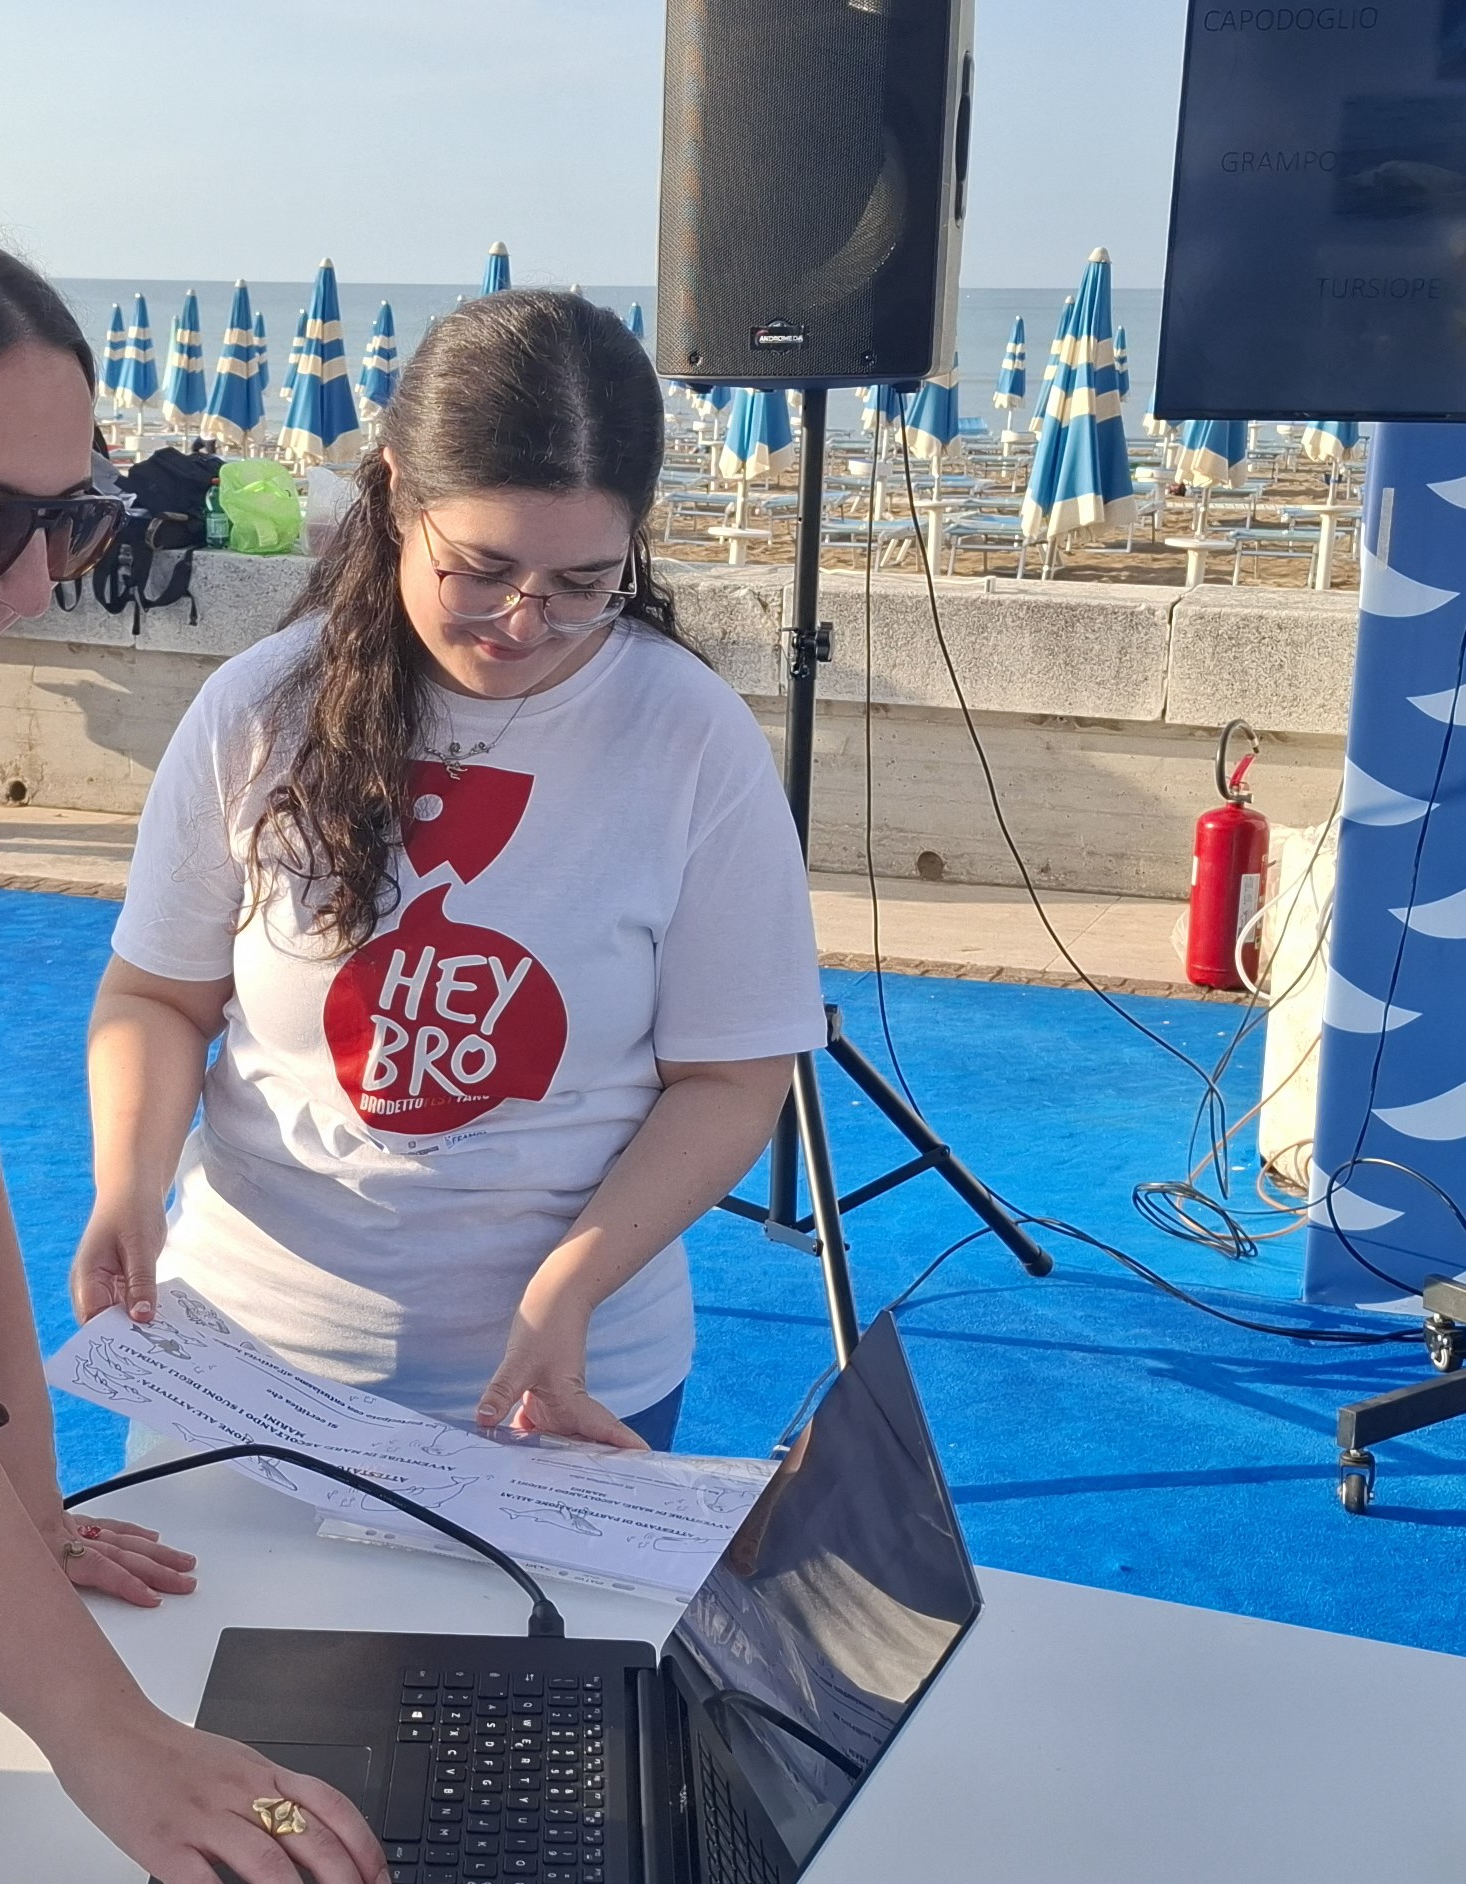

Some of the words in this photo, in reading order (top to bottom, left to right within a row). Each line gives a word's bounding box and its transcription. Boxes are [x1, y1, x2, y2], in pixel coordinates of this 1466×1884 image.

[1203, 6, 1379, 33] CAPODOGLIO
[1220, 150, 1338, 174] GRAMPO
[1316, 277, 1441, 300] TURSIOPE
[378, 945, 533, 1036] HEY
[359, 1014, 497, 1097] BRO
[359, 1092, 424, 1116] BRODETTO
[118, 1344, 167, 1370] ANIMALI
[167, 1368, 202, 1390] DEGLI
[201, 1387, 238, 1410] SUONI
[266, 1388, 284, 1401] che
[294, 1376, 345, 1407] entusiasmo
[285, 1398, 326, 1424] certifica
[347, 1405, 365, 1416] con
[244, 1412, 322, 1448] ASCOLTANDO
[263, 1413, 306, 1438] MARINI
[379, 1454, 456, 1471] AVVENTURE
[635, 1521, 695, 1538] ATTESTATO
